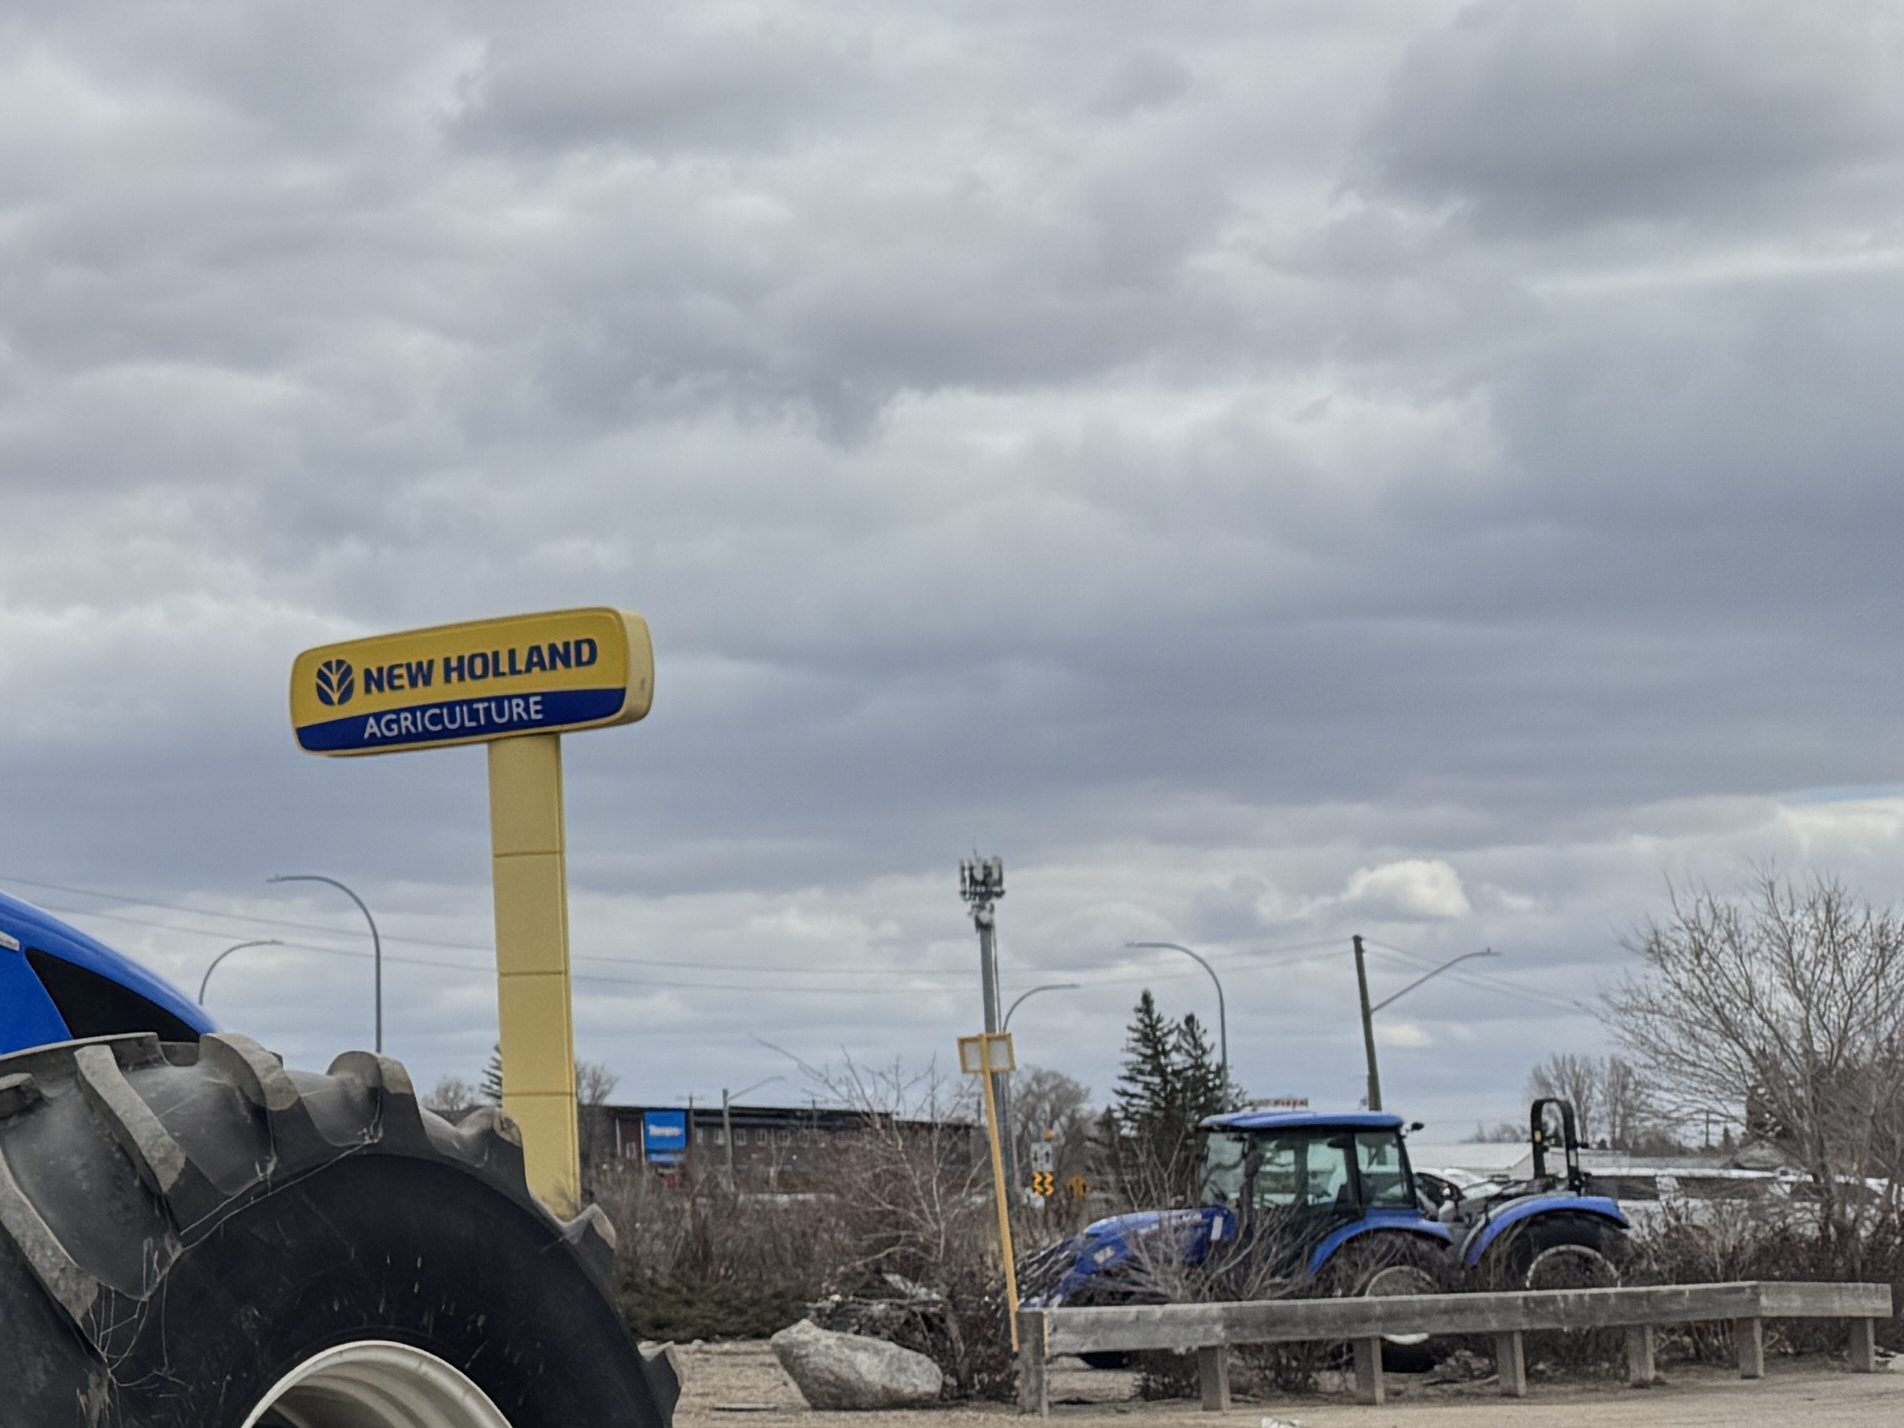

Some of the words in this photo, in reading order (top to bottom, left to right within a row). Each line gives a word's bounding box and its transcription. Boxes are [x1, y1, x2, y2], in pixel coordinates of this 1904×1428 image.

[364, 658, 435, 695] NEW
[444, 638, 598, 685] HOLLAND
[363, 695, 545, 740] AGRICULTURE
